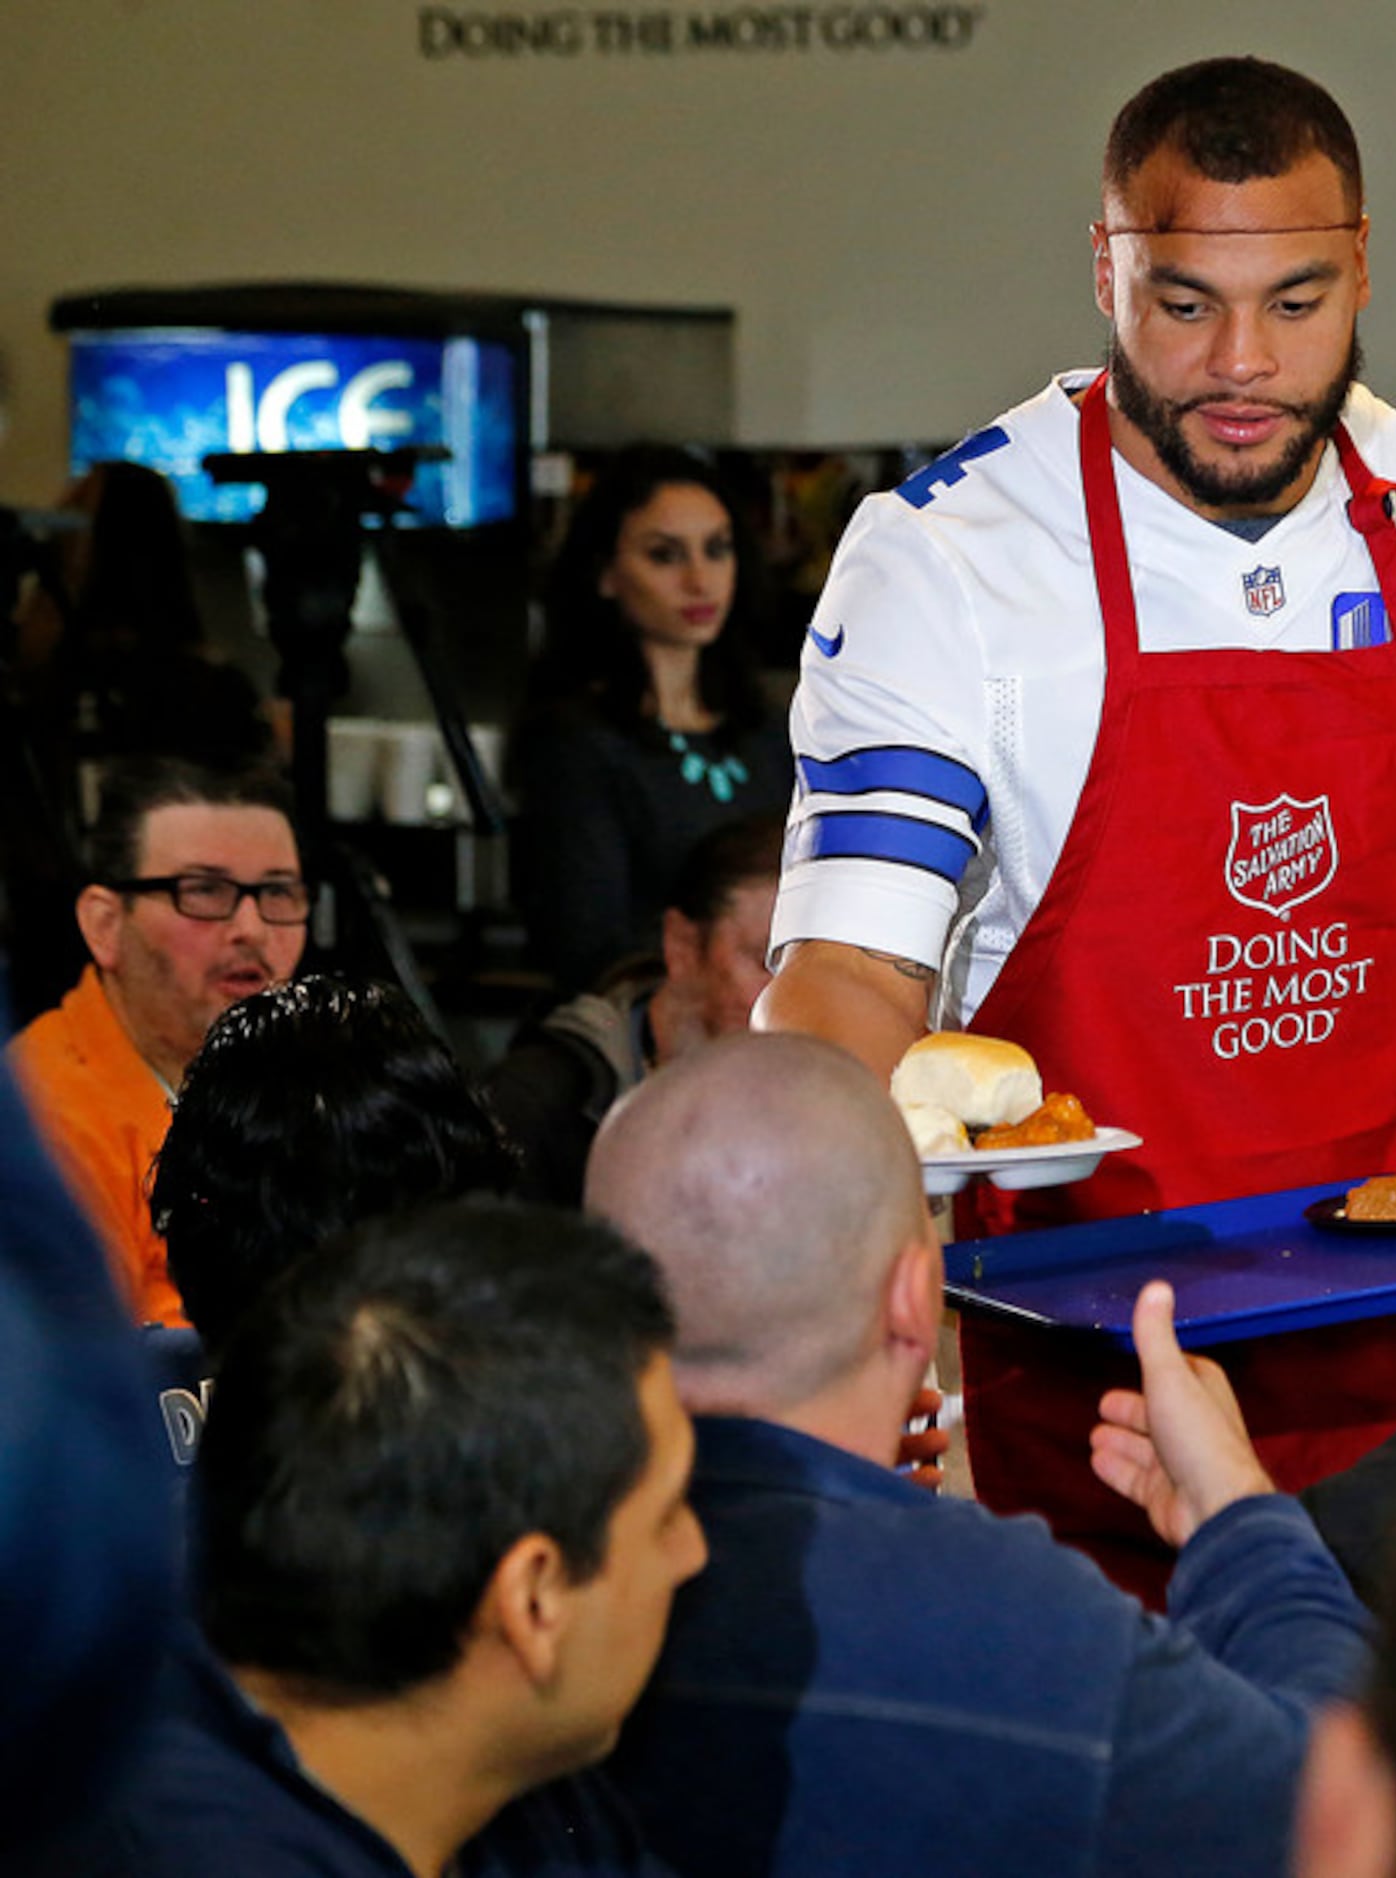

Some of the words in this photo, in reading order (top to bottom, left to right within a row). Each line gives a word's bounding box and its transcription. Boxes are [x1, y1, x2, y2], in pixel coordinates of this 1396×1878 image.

[418, 7, 584, 58] DOING
[594, 12, 674, 54] THE
[687, 9, 813, 51] MOST
[819, 6, 977, 51] GOOD
[1247, 585, 1284, 611] NFL
[1233, 811, 1326, 888] SALVATION
[1249, 809, 1292, 848] THE
[1263, 846, 1323, 901] ARMY
[1206, 922, 1348, 975] DOING
[1173, 977, 1253, 1019] THE
[1262, 957, 1375, 1009] MOST
[1212, 1008, 1336, 1060] GOOD
